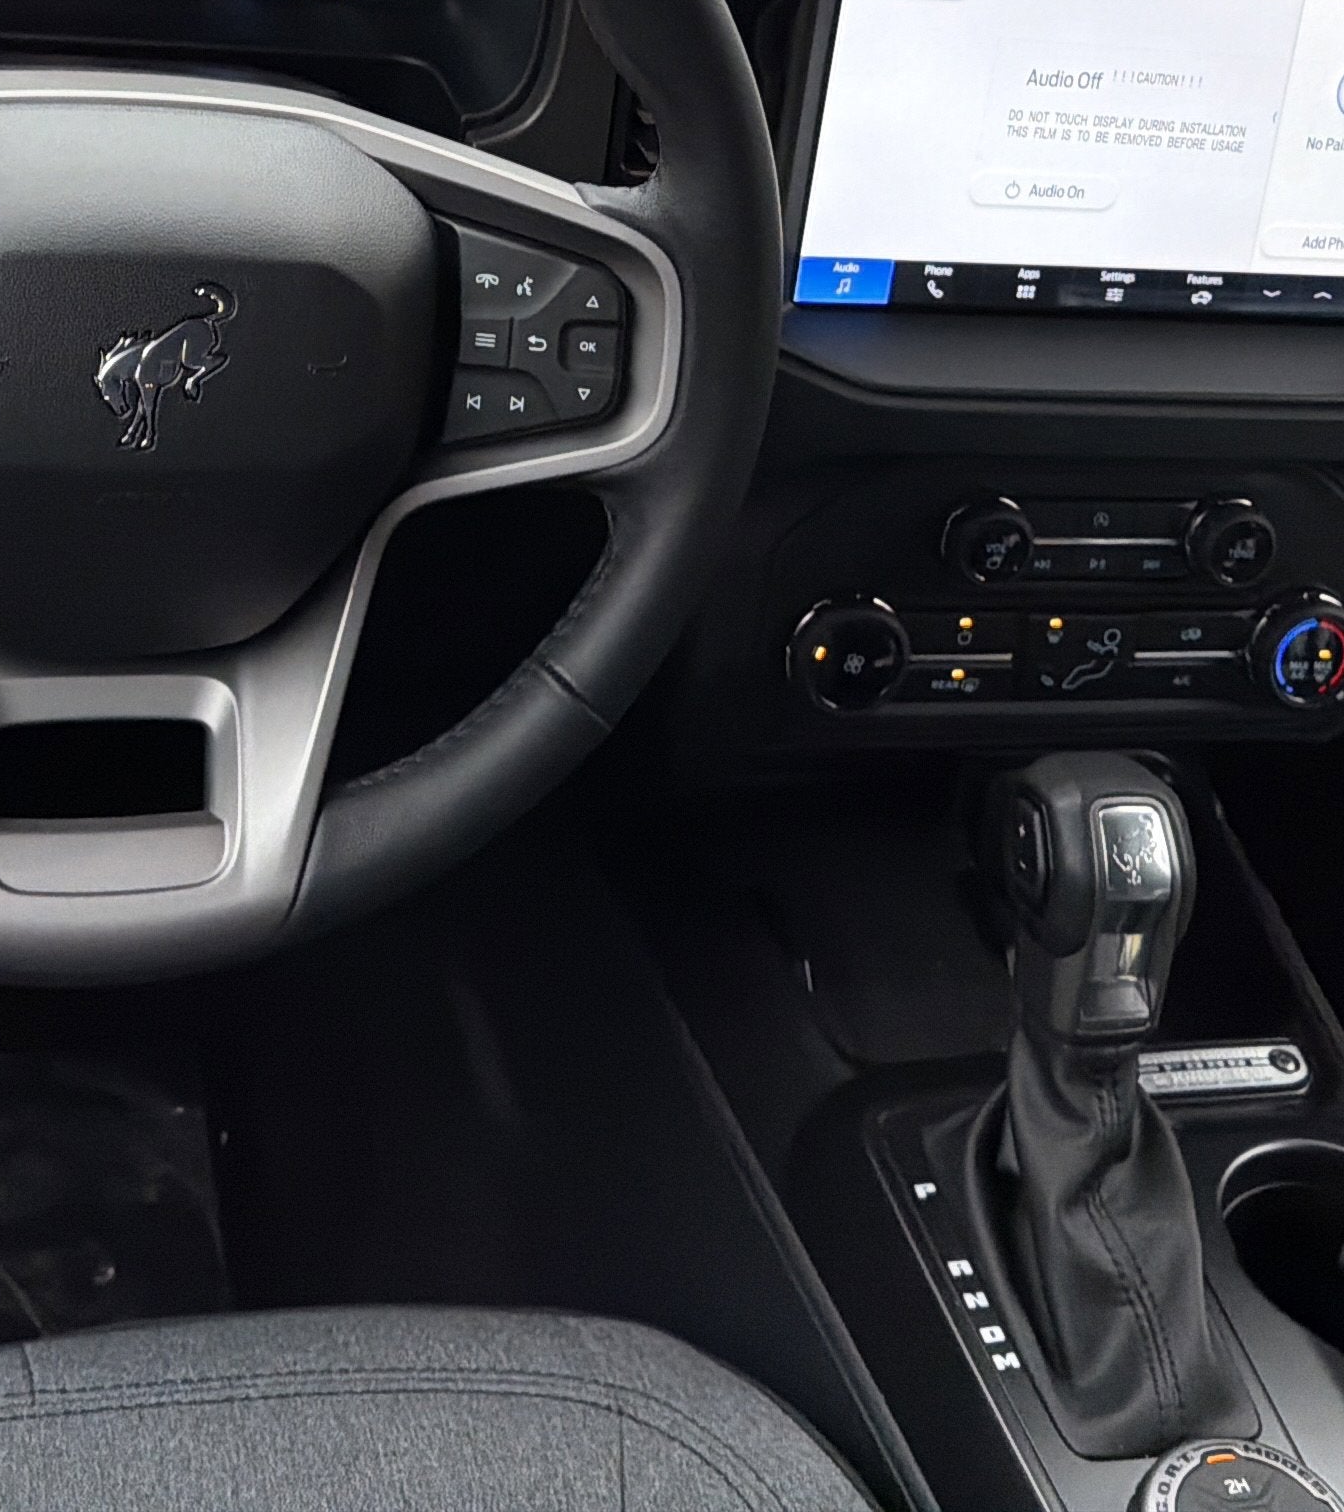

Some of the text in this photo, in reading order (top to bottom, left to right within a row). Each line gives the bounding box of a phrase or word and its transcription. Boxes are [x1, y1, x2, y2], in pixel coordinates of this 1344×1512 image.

[1026, 68, 1104, 90] Audio Off
[1008, 108, 1247, 138] DO NOT TOUCH DISPLAY DURING INSTALLATION
[1007, 125, 1245, 153] THIS FILM IS TO BE REMOVED BEFORE USAGE
[1305, 137, 1323, 150] No
[1029, 183, 1085, 200] Audio On
[1302, 236, 1327, 249] Add
[833, 261, 860, 274] Audio
[924, 264, 953, 277] Phone
[1017, 266, 1041, 281] Apps
[1100, 270, 1136, 285] Settings
[1186, 273, 1224, 286] Features
[579, 340, 596, 353] OK
[914, 1181, 937, 1200] P
[947, 1259, 974, 1277] R
[963, 1291, 990, 1310] N
[979, 1325, 1006, 1345] D
[992, 1352, 1021, 1372] M
[1243, 1444, 1328, 1496] MODES
[1224, 1477, 1251, 1495] 2H
